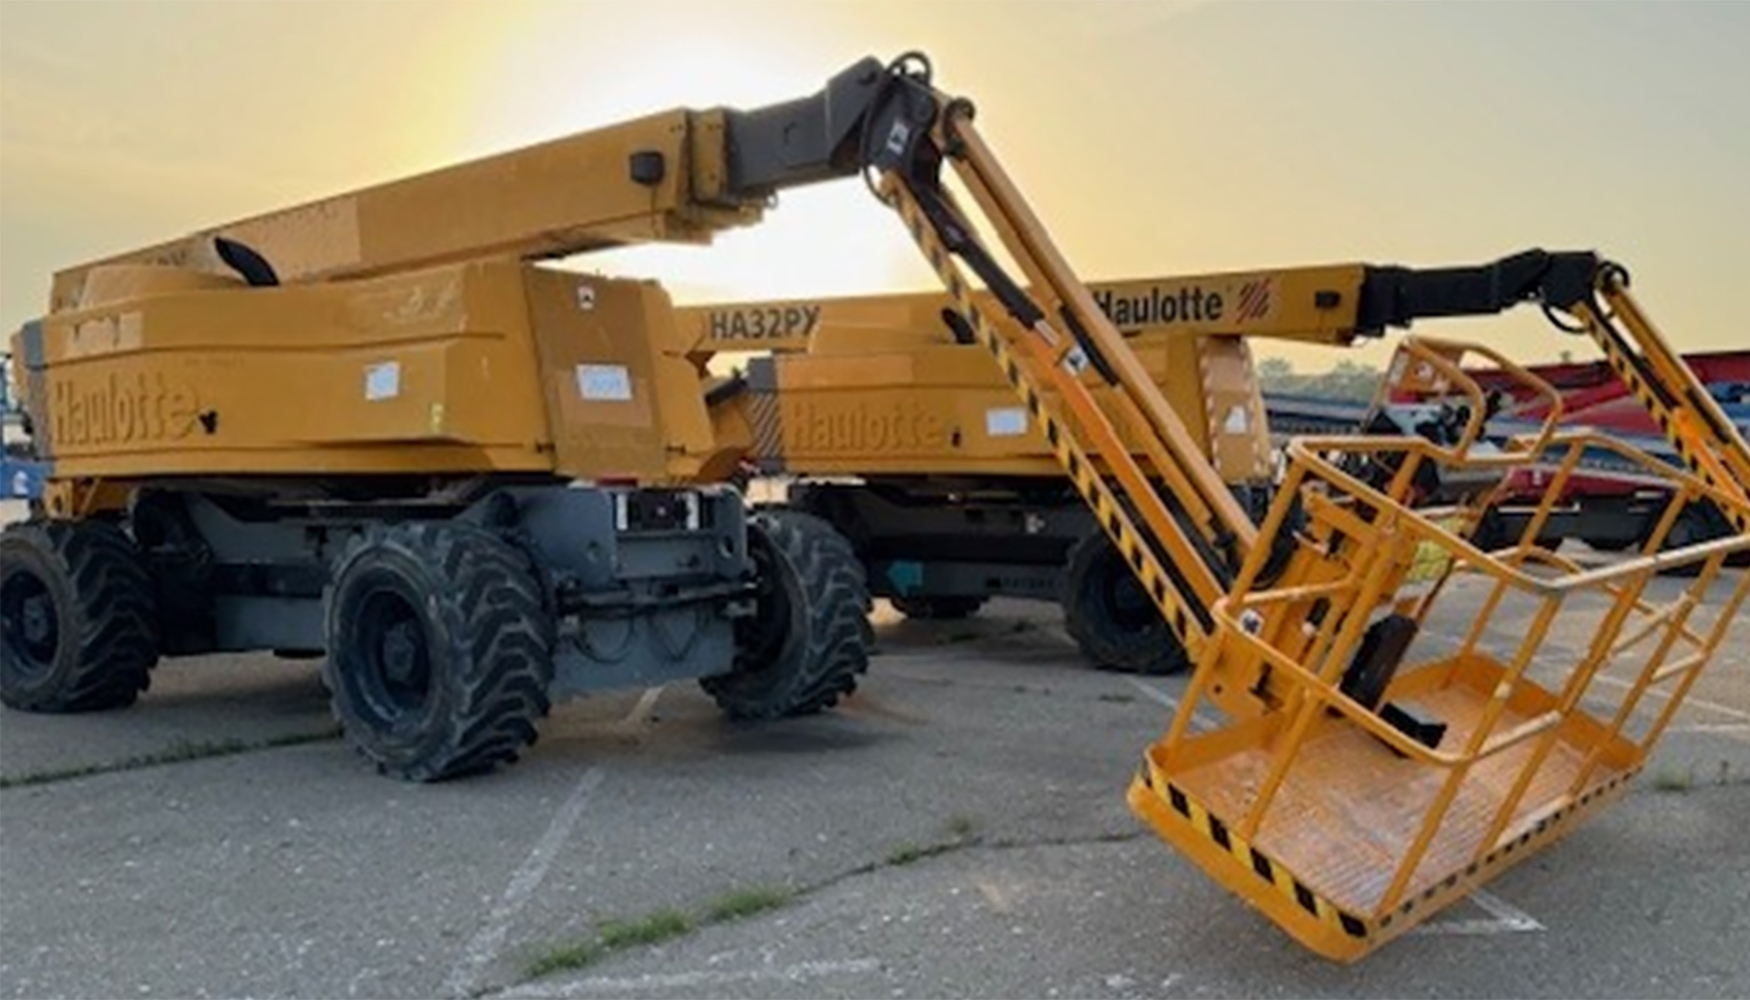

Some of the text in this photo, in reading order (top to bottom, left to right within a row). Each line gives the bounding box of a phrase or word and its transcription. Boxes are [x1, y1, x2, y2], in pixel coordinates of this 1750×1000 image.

[710, 305, 821, 339] HA32PY
[1093, 286, 1223, 325] Haulotte
[54, 373, 201, 446] Haulotte
[792, 402, 941, 451] Haulotte
